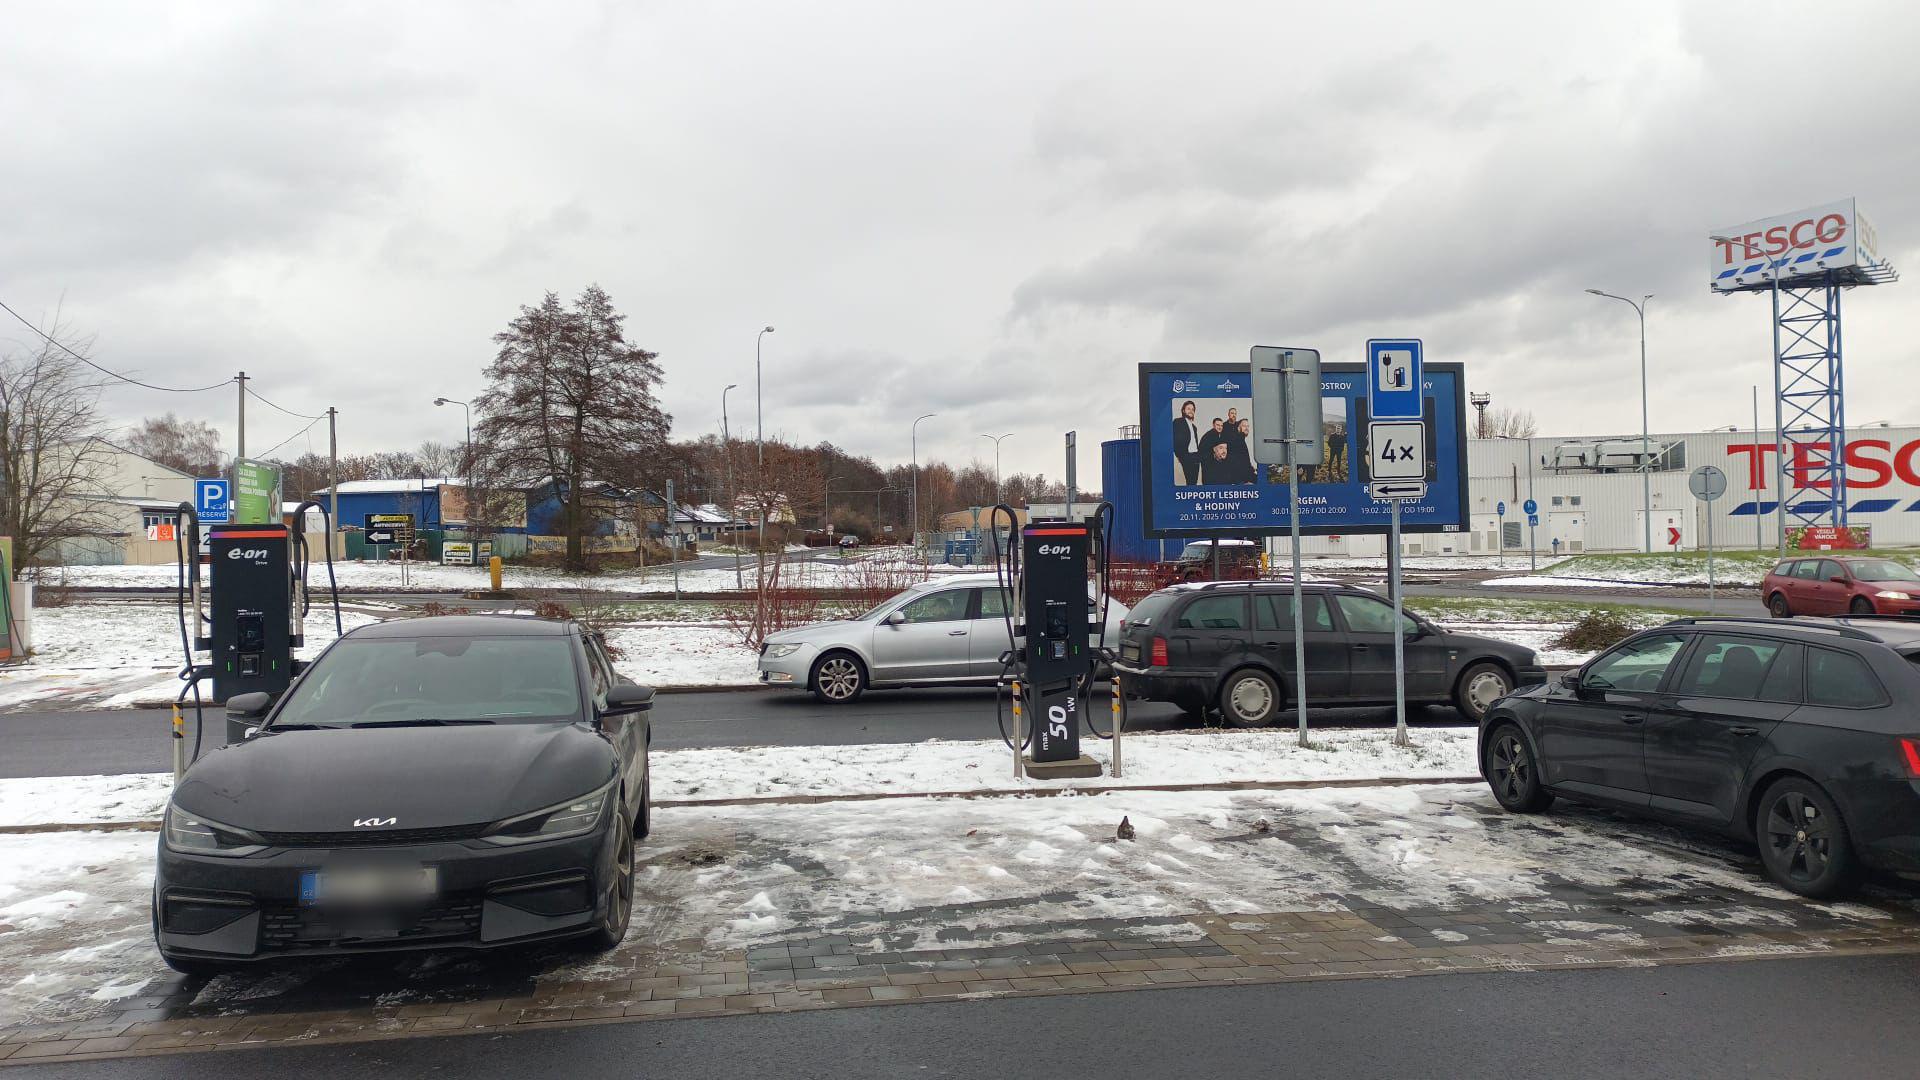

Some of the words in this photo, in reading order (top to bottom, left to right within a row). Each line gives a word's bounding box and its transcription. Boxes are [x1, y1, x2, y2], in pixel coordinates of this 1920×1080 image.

[1716, 213, 1846, 264] TESCO
[203, 484, 223, 509] P
[1175, 491, 1216, 500] SUPPORT
[1219, 490, 1259, 499] LESBIENS
[1296, 496, 1328, 505] RGEMA
[1195, 502, 1202, 511] &
[1204, 502, 1240, 511] HODINY
[1225, 512, 1236, 520] OD
[1048, 705, 1068, 740] 50
[1067, 696, 1076, 712] kW
